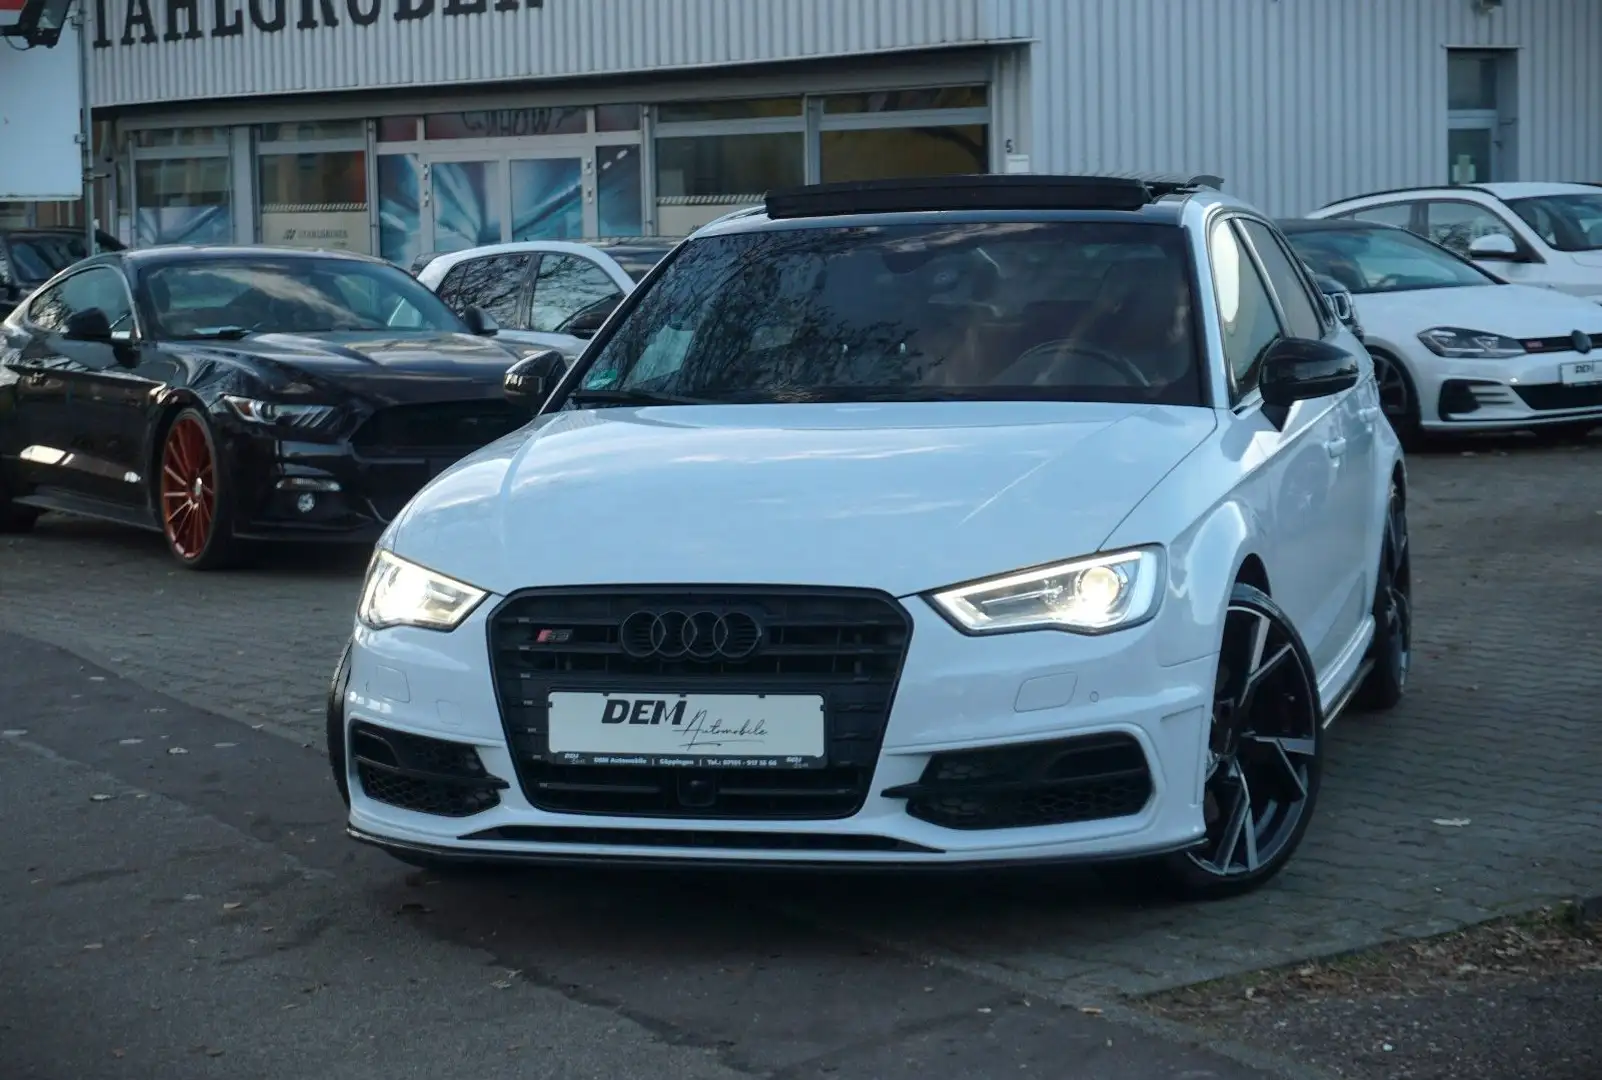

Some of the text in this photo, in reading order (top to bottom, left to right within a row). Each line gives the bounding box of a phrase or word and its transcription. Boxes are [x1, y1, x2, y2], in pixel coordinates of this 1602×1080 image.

[1005, 138, 1013, 154] 5
[601, 699, 687, 725] DEM
[672, 709, 768, 751] Automobile
